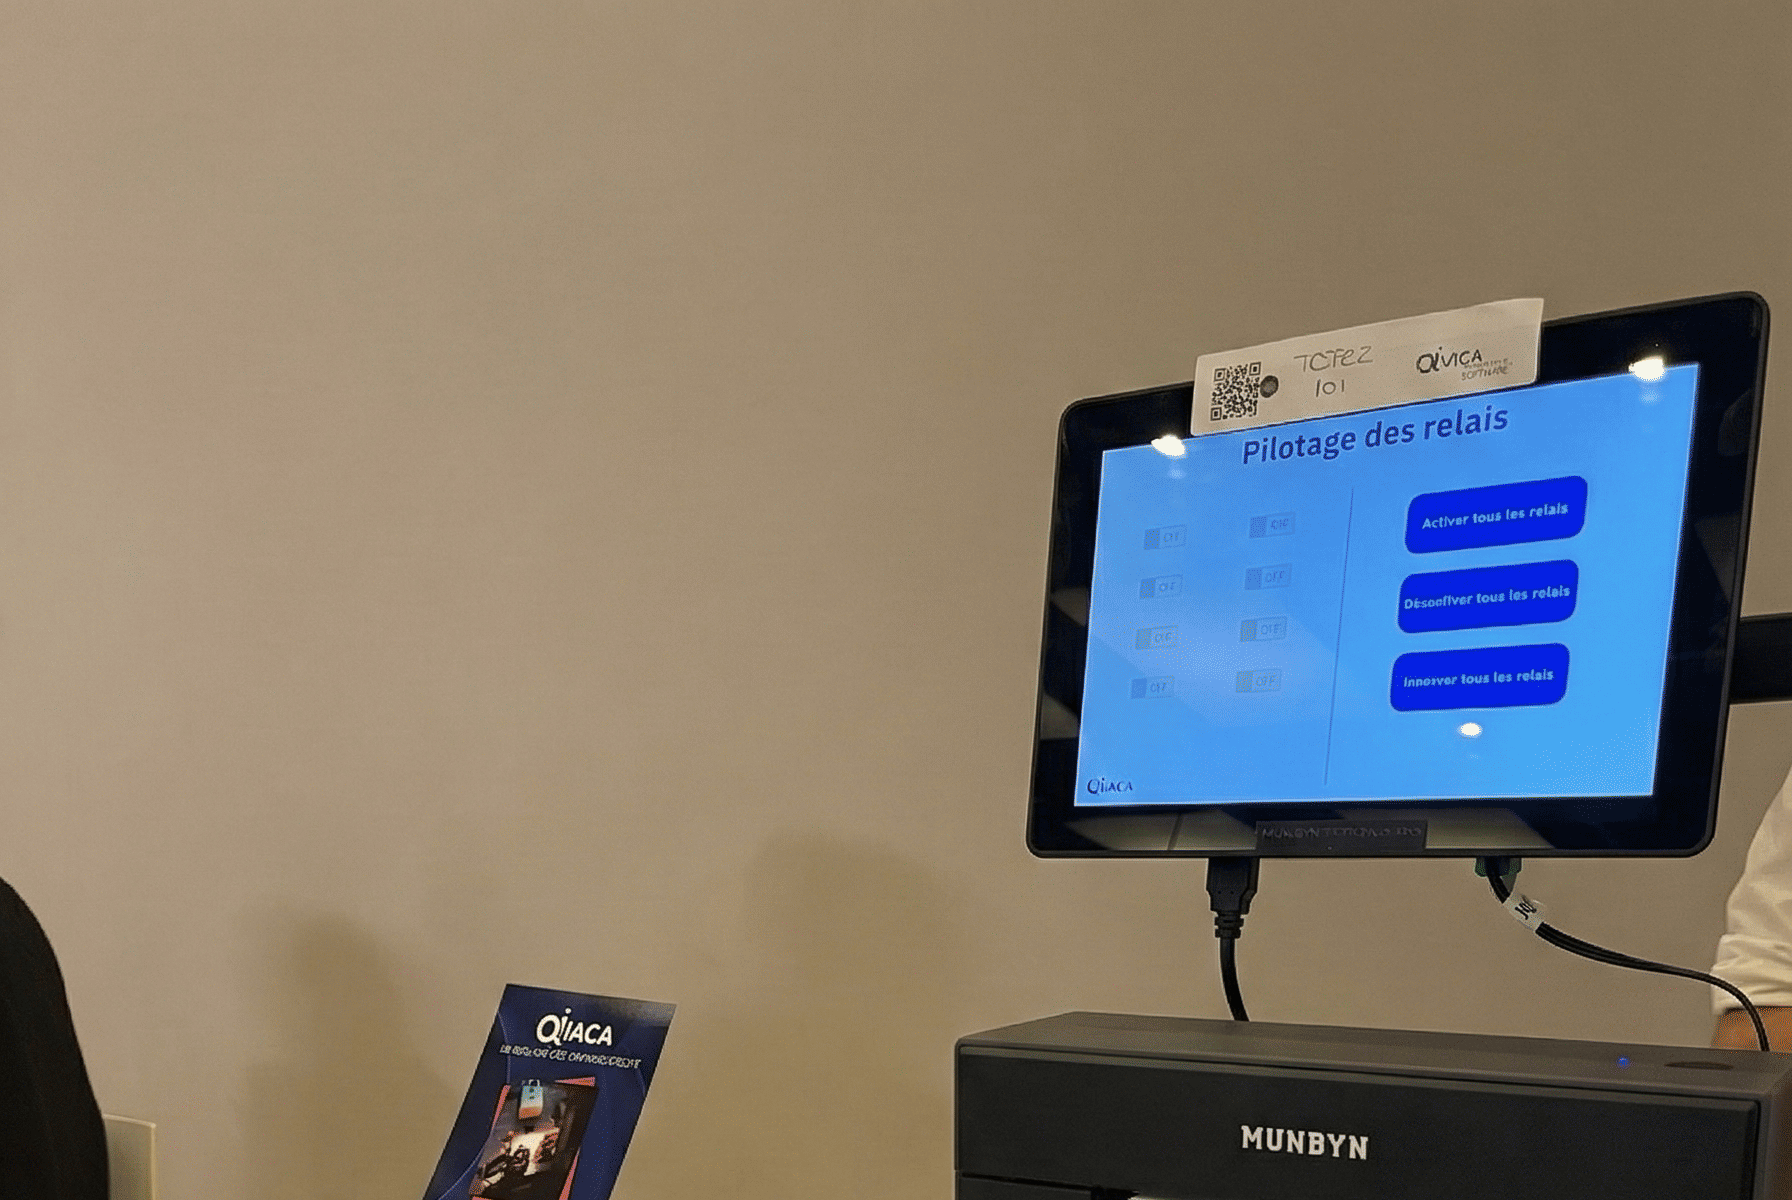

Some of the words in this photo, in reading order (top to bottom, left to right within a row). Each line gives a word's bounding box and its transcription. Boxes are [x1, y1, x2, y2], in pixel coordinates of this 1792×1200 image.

[1243, 429, 1356, 464] Pilotage
[1364, 420, 1415, 448] des
[1424, 404, 1509, 440] relais
[1421, 515, 1469, 530] Activer
[1472, 511, 1502, 524] tous
[1505, 508, 1525, 520] les
[1529, 501, 1569, 518] relais
[1476, 591, 1505, 604] tous
[1509, 588, 1528, 601] les
[1532, 584, 1571, 599] relais
[1461, 673, 1490, 685] tous
[1493, 670, 1513, 683] les
[1516, 668, 1554, 682] relais
[1241, 1125, 1369, 1160] MUNBYN
